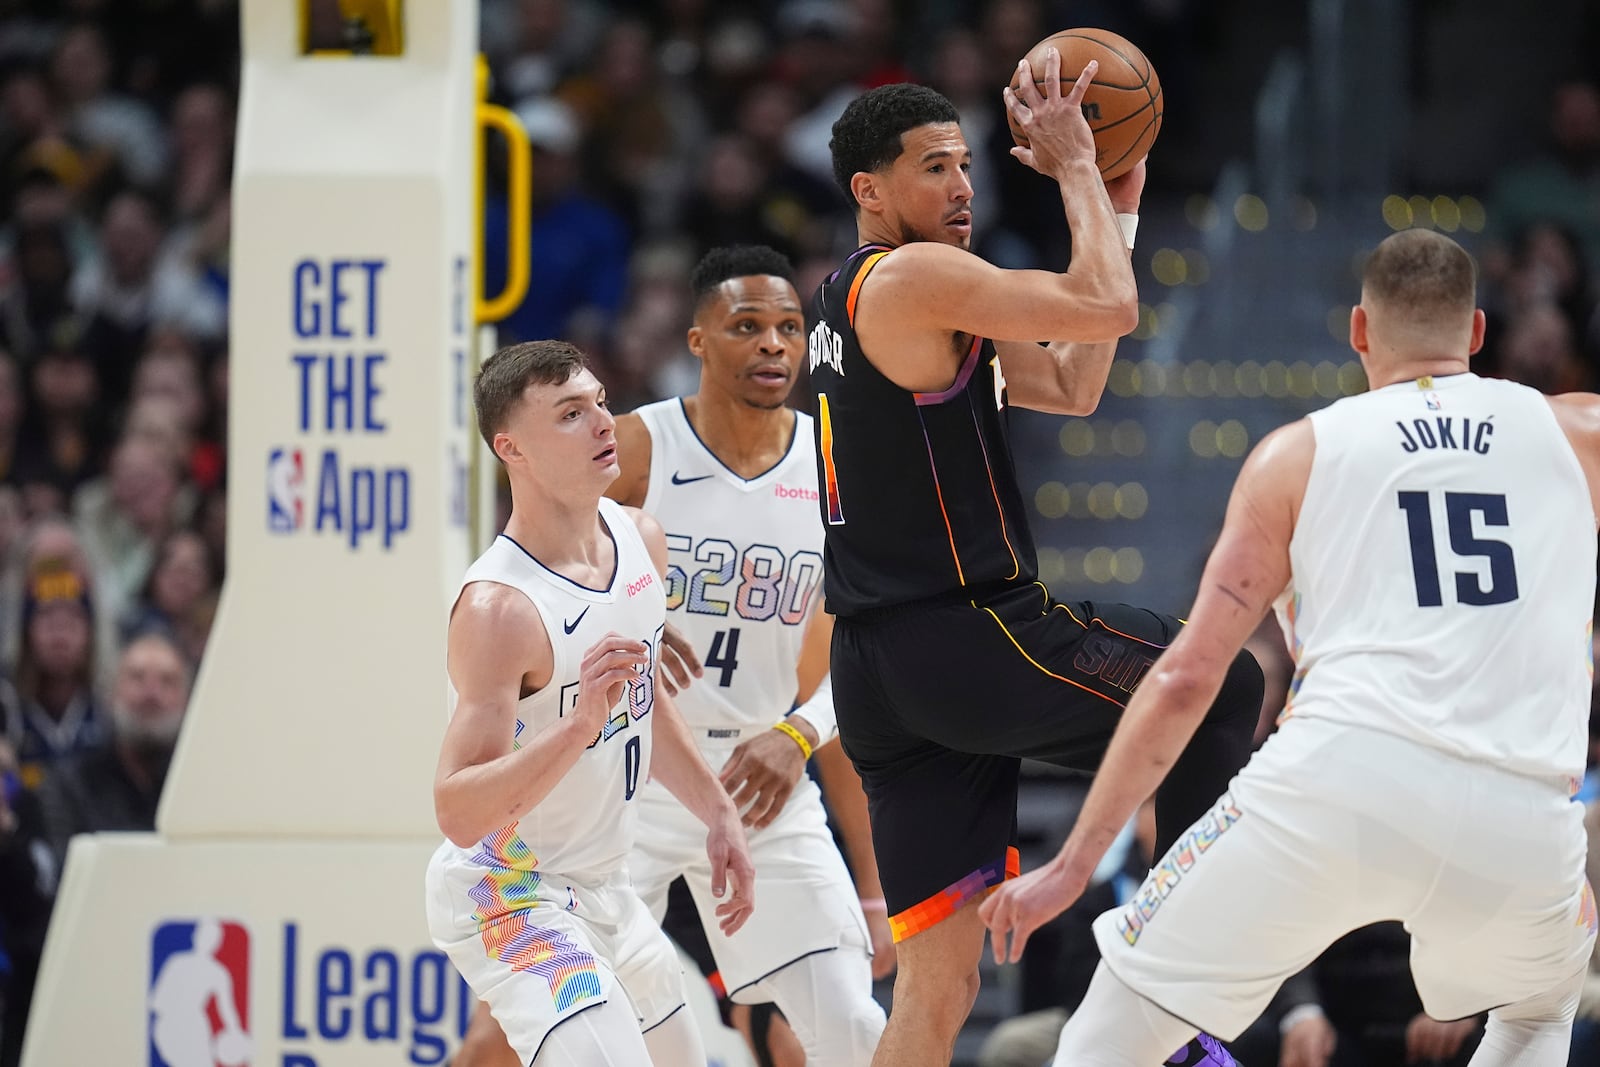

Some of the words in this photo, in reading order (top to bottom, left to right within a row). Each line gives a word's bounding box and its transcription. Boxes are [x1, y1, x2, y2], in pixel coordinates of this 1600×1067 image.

[293, 258, 387, 339] GET
[292, 352, 387, 433] THE
[817, 392, 846, 526] 1
[1396, 414, 1494, 455] JOKIĆ
[313, 447, 411, 552] App
[774, 483, 819, 501] ibotta
[1398, 490, 1520, 608] 15
[625, 572, 653, 598] ibotta
[704, 627, 741, 688] 4
[1073, 630, 1156, 695] SUN
[625, 735, 641, 801] 0
